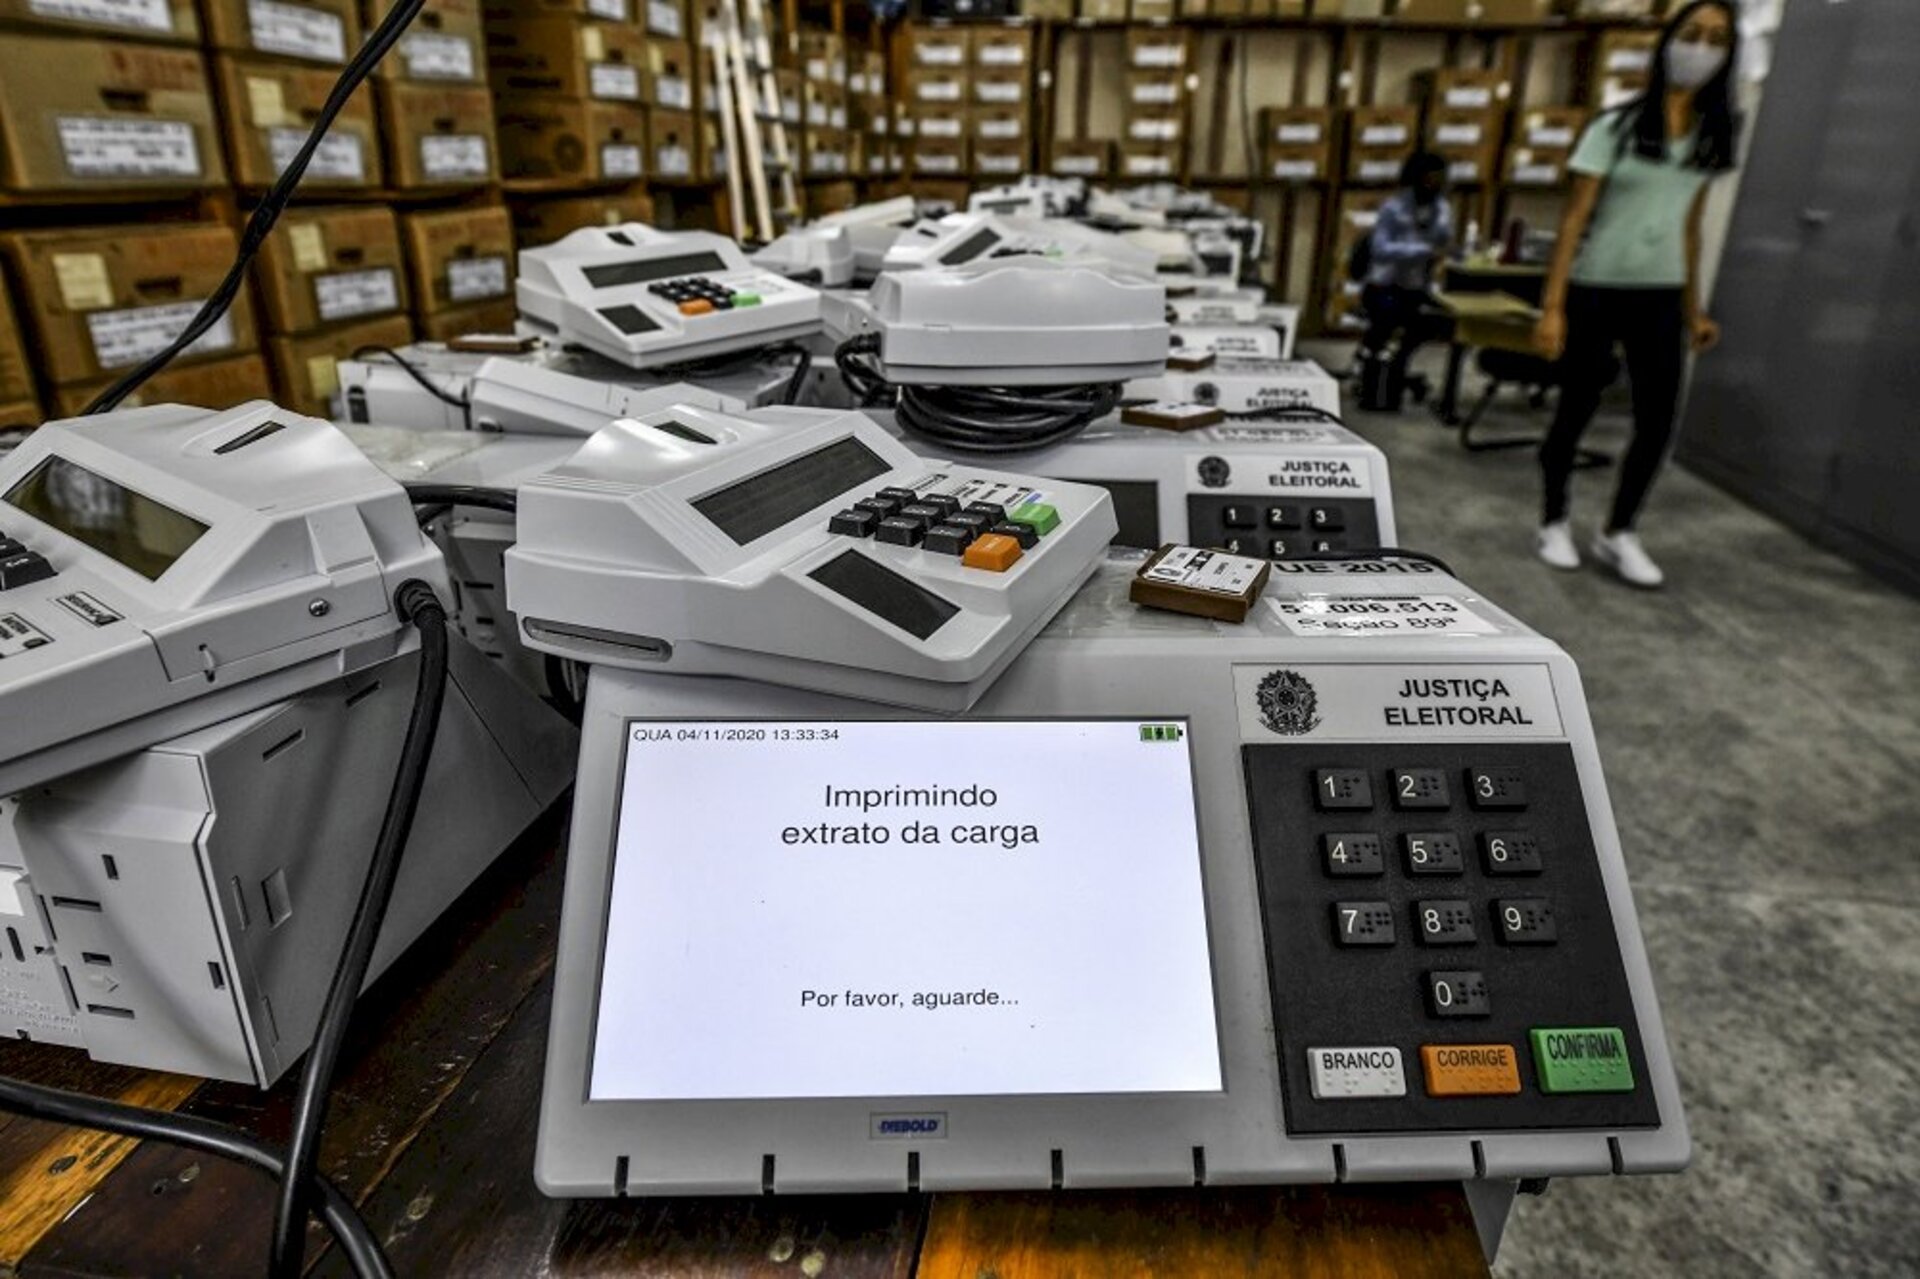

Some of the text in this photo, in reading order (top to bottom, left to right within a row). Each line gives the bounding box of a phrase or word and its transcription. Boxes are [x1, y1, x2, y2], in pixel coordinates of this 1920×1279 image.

[1281, 461, 1351, 474] JUSTIÇA
[1269, 475, 1361, 488] ELEITORAL
[1229, 508, 1236, 521] 1
[1271, 508, 1282, 522] 2
[1316, 509, 1327, 523] 3
[1274, 540, 1286, 554] 5
[1275, 562, 1434, 573] UE 2015
[1280, 602, 1459, 615] 5.006.513
[1398, 679, 1511, 701] JUSTIÇA
[1384, 706, 1533, 727] ELEITORAL
[633, 728, 840, 741] QUA 04/11/2020 13:33:34
[1324, 776, 1336, 798] 1
[1399, 776, 1416, 798] 2
[1477, 776, 1494, 798] 3
[825, 784, 998, 813] Imprimindo
[781, 821, 1041, 849] extrato da carga
[1331, 841, 1348, 863] 4
[1412, 841, 1428, 863] 5
[1490, 839, 1508, 862] 6
[1341, 909, 1358, 934] 7
[1424, 909, 1441, 933] 8
[1504, 907, 1522, 931] 9
[801, 989, 1019, 1011] Por favor, aguarde...
[1435, 980, 1453, 1006] 0
[1437, 1049, 1508, 1067] CORRIGE
[1547, 1034, 1622, 1060] CONFIRMA
[1322, 1052, 1395, 1069] BRANCO
